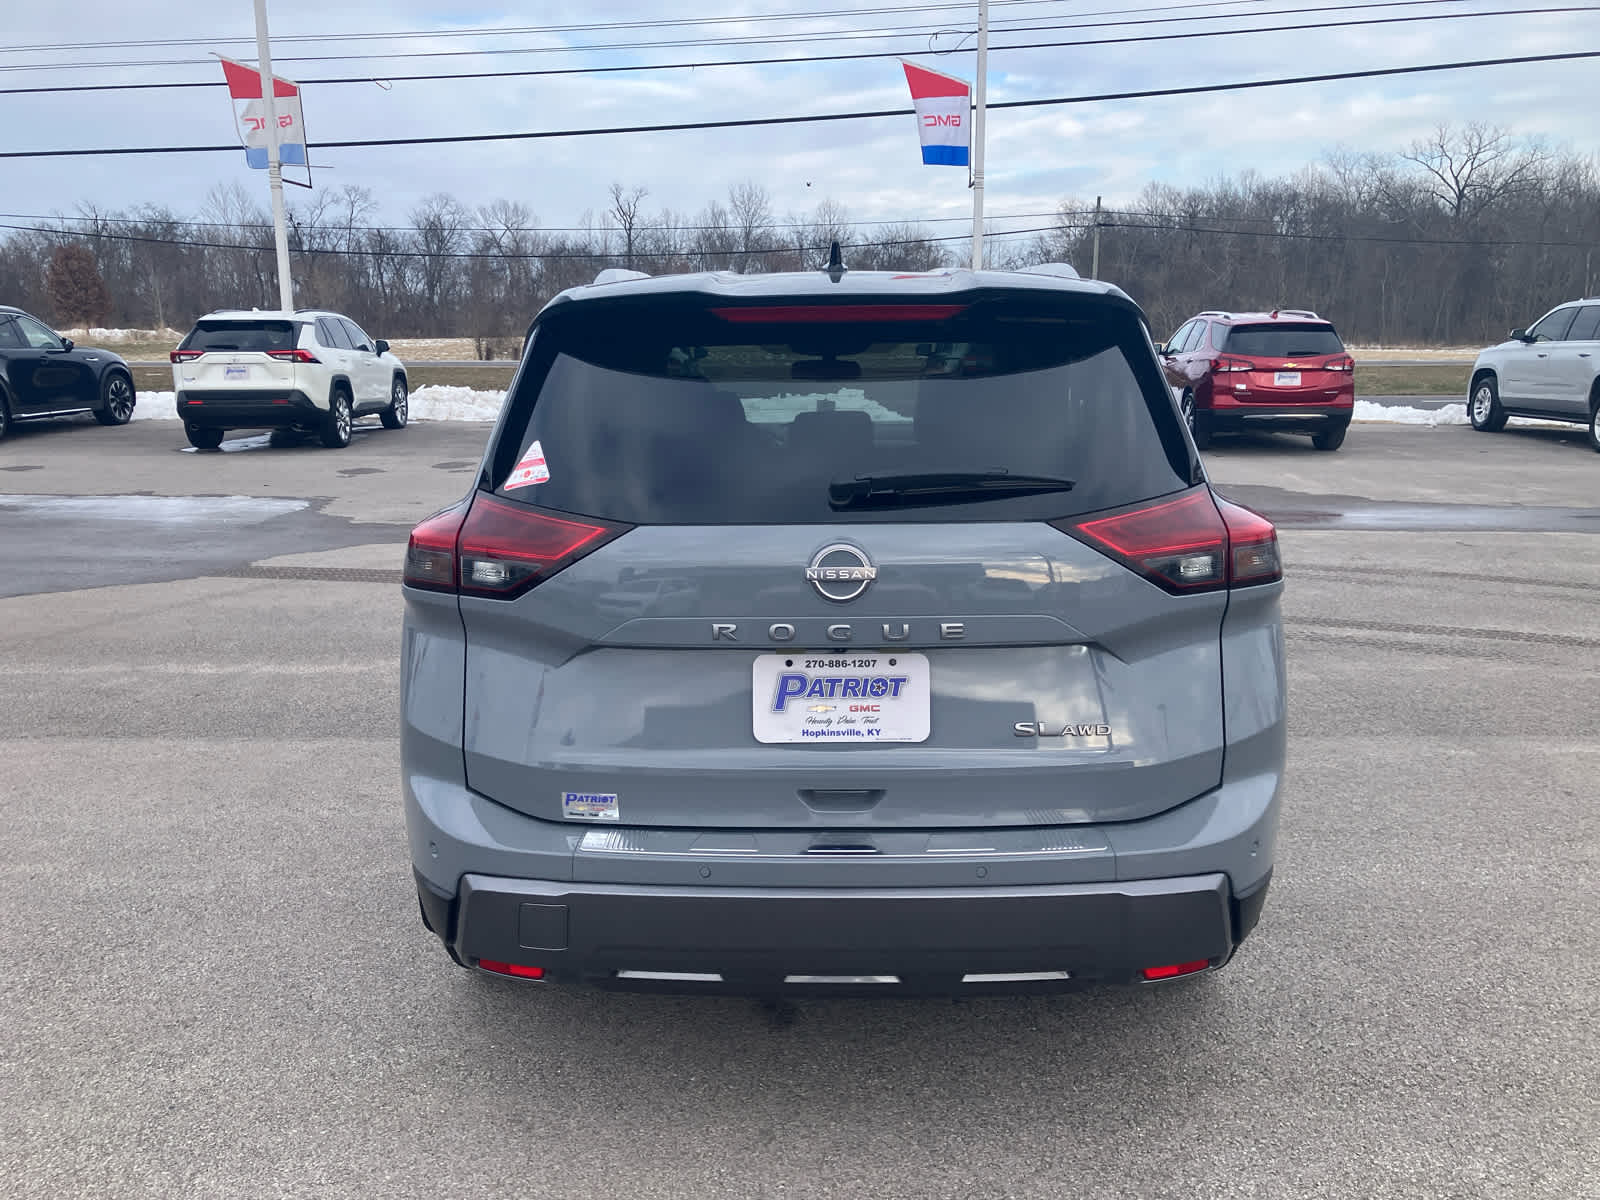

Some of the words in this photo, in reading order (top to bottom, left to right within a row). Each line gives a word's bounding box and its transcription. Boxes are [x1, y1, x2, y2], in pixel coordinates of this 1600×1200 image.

[806, 568, 877, 580] NISSAN
[711, 623, 967, 641] ROGUE
[805, 659, 877, 669] 270-886-1207
[772, 672, 908, 712] PATRIOT
[849, 704, 881, 712] GMC
[802, 728, 865, 738] Hopkinsville,
[867, 728, 881, 736] KY
[1014, 721, 1062, 737] SL
[1062, 724, 1112, 737] AWD
[565, 793, 616, 806] PATRIOT
